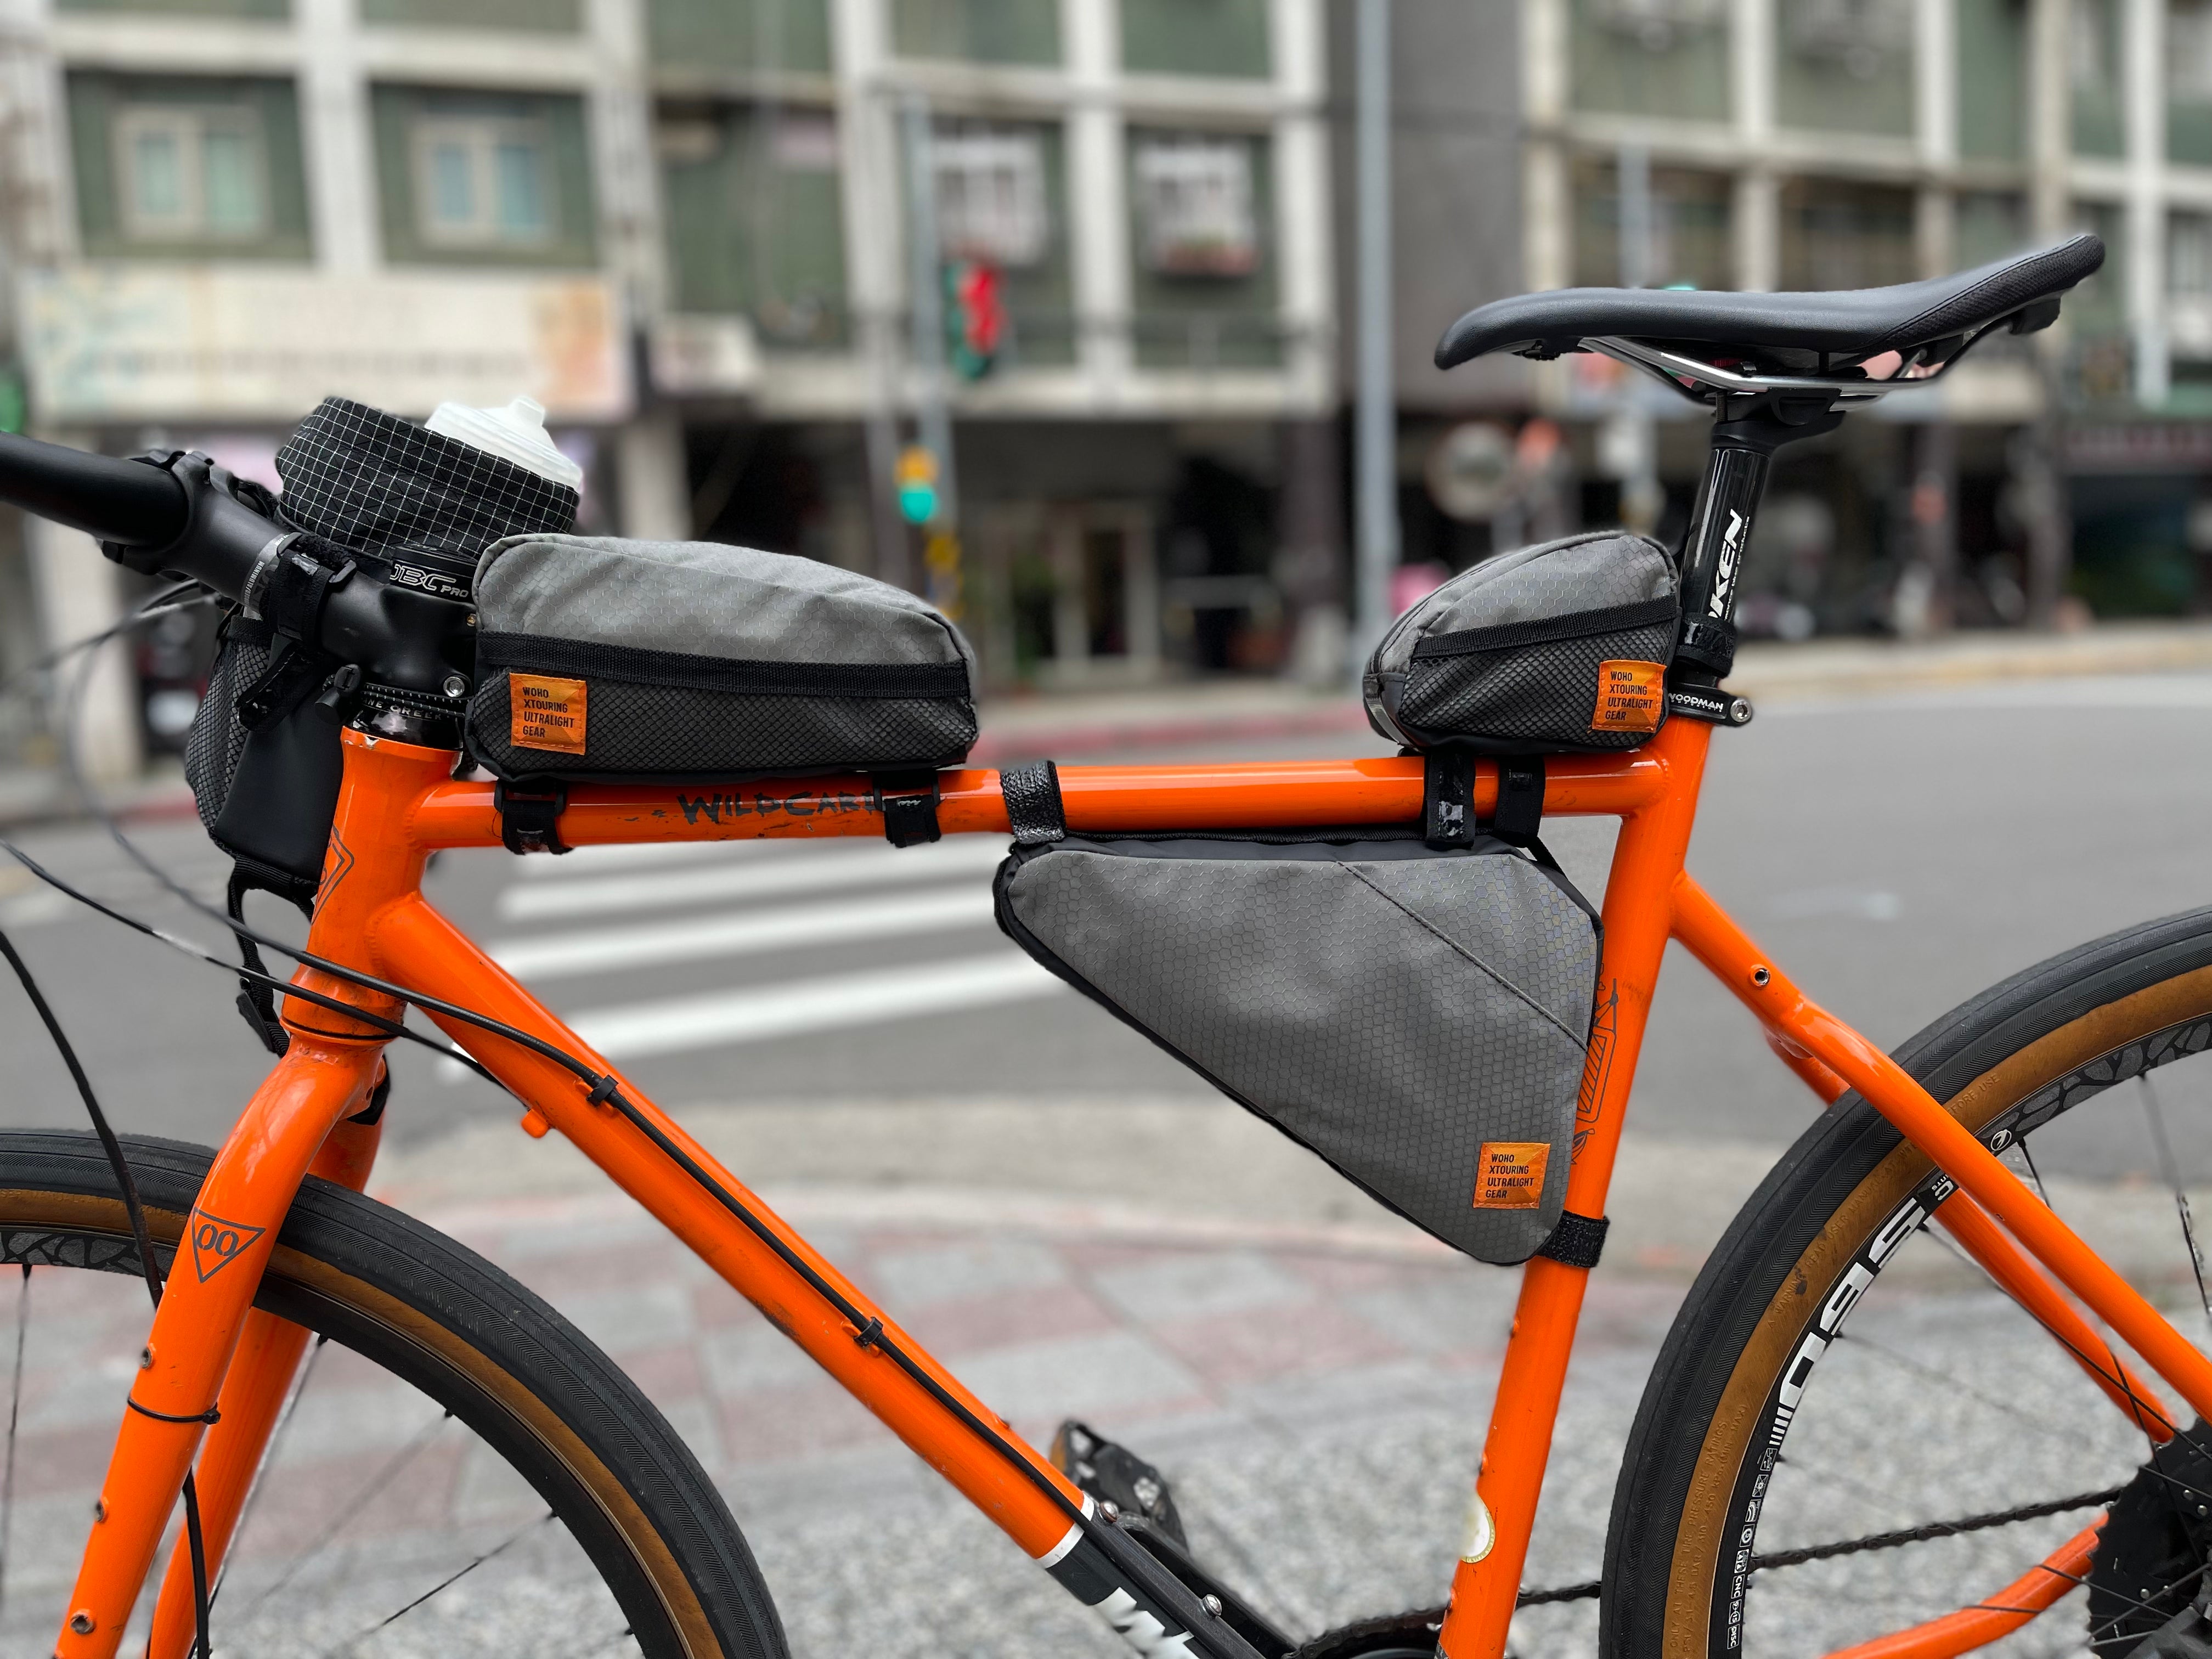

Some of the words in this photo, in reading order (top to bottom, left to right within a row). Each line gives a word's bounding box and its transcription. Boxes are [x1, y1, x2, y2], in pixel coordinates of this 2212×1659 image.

[1708, 508, 1742, 618] KEN
[440, 585, 469, 598] PRO
[1610, 671, 1633, 681] WOHO
[522, 686, 549, 698] WOHO
[1609, 684, 1647, 696] XTOURING
[523, 698, 568, 713] XTOURING
[1607, 697, 1654, 709] ULTRALIGHT
[524, 711, 575, 728] ULTRALIGHT
[1605, 710, 1627, 720] GEAR
[522, 725, 546, 738] GEAR
[1491, 1153, 1515, 1163] WOHO
[1488, 1165, 1529, 1175] XTOURING
[1487, 1177, 1534, 1187] ULTRALIGHT
[1486, 1189, 1508, 1198] GEAR
[1734, 1575, 1742, 1598] CNC
